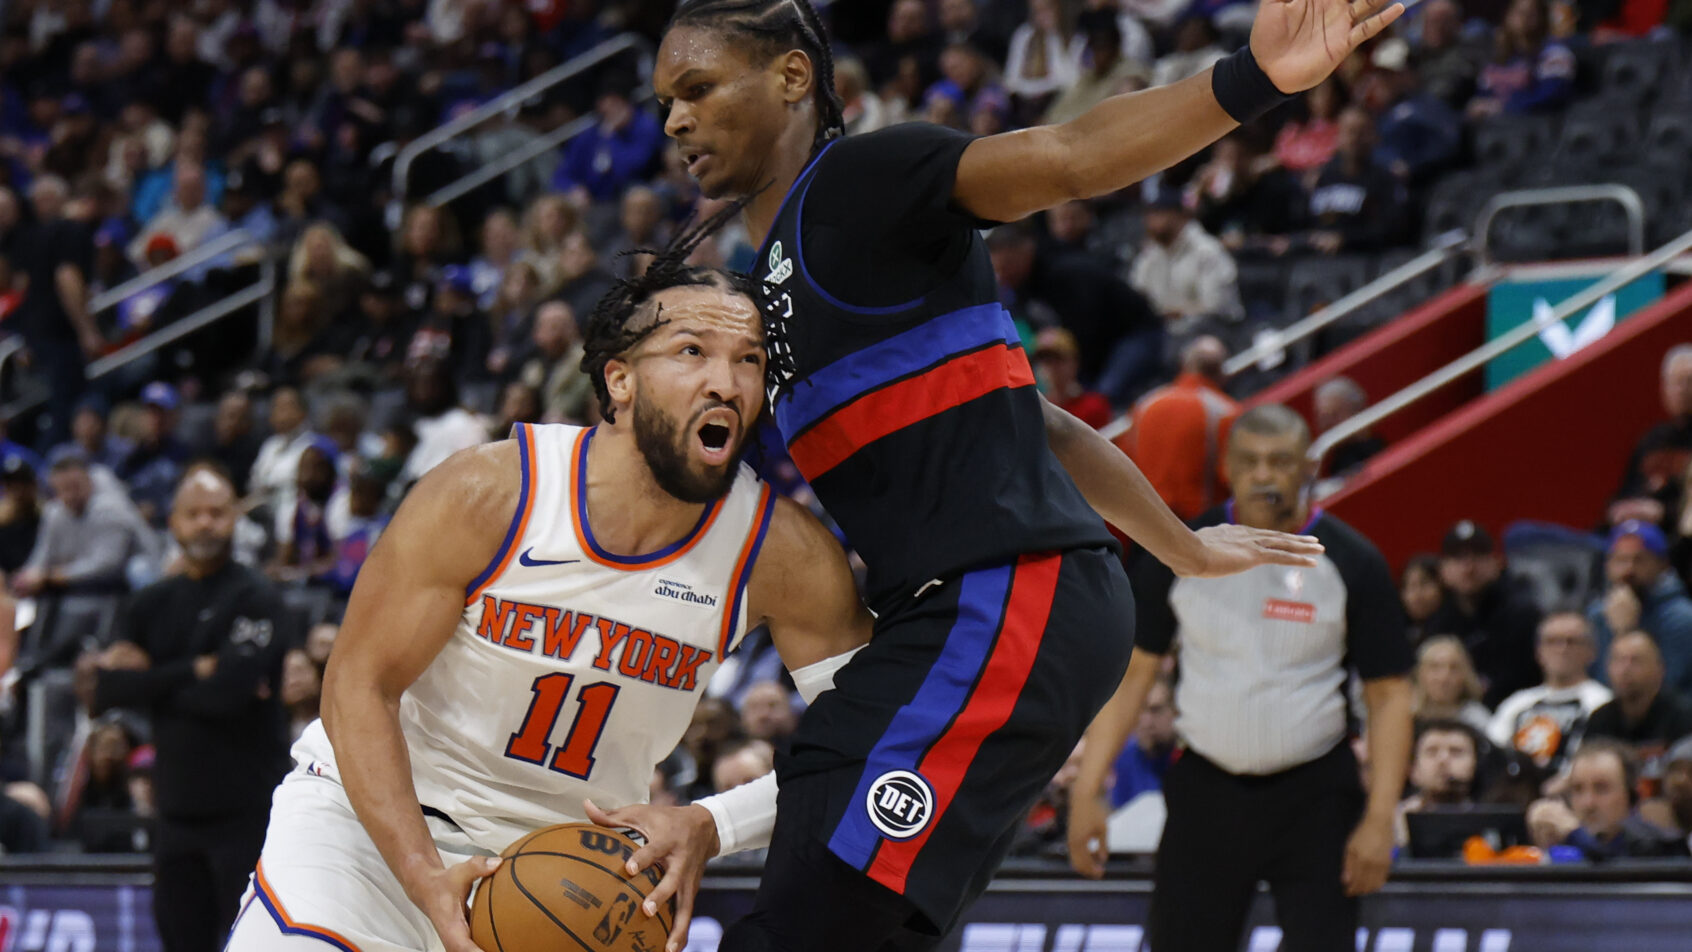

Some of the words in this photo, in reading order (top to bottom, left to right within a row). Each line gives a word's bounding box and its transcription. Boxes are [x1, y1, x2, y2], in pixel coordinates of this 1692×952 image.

[654, 586, 680, 599] abu
[681, 591, 718, 607] dhabi
[477, 594, 594, 661] NEW
[591, 615, 713, 692] YORK
[504, 671, 621, 781] 11
[878, 783, 924, 823] DET
